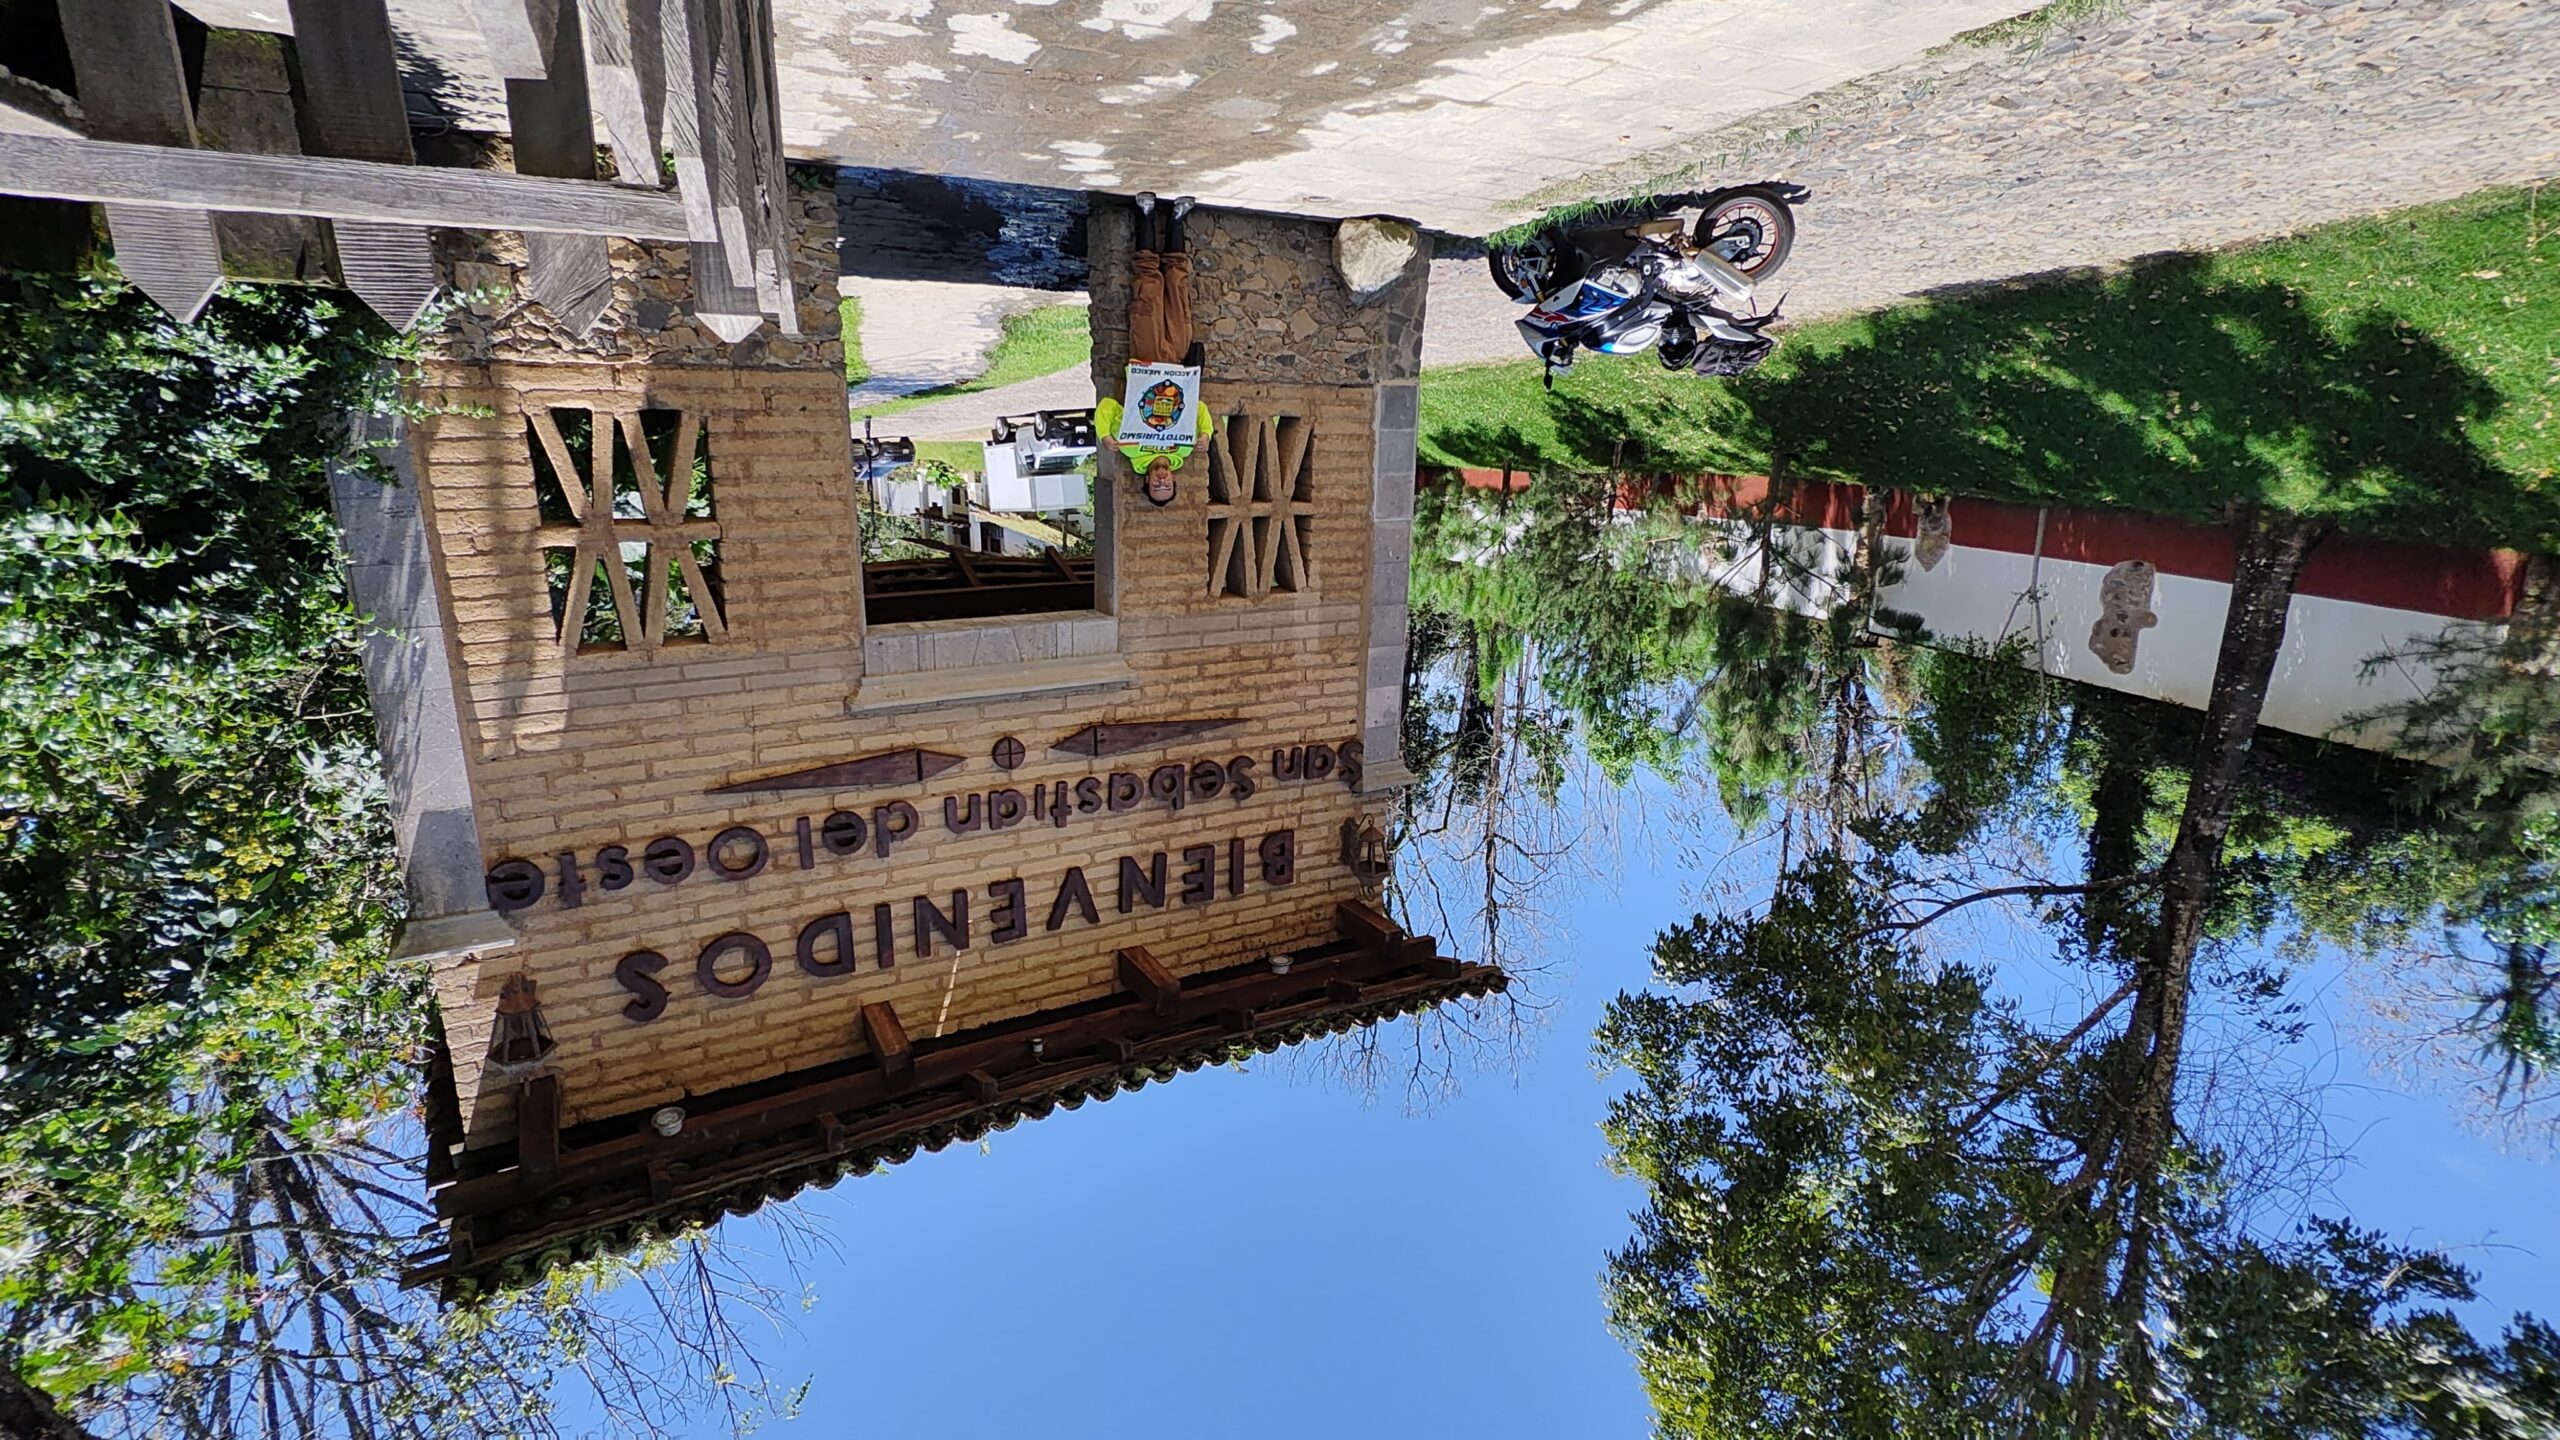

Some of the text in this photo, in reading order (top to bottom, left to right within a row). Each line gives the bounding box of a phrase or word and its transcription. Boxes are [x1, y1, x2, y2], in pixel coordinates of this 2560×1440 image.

[1130, 367, 1161, 377] MÉXICO
[1271, 739, 1365, 794] San
[486, 825, 769, 911] Oeste
[797, 800, 920, 871] del
[614, 828, 1296, 1022] BIENVENIDOS
